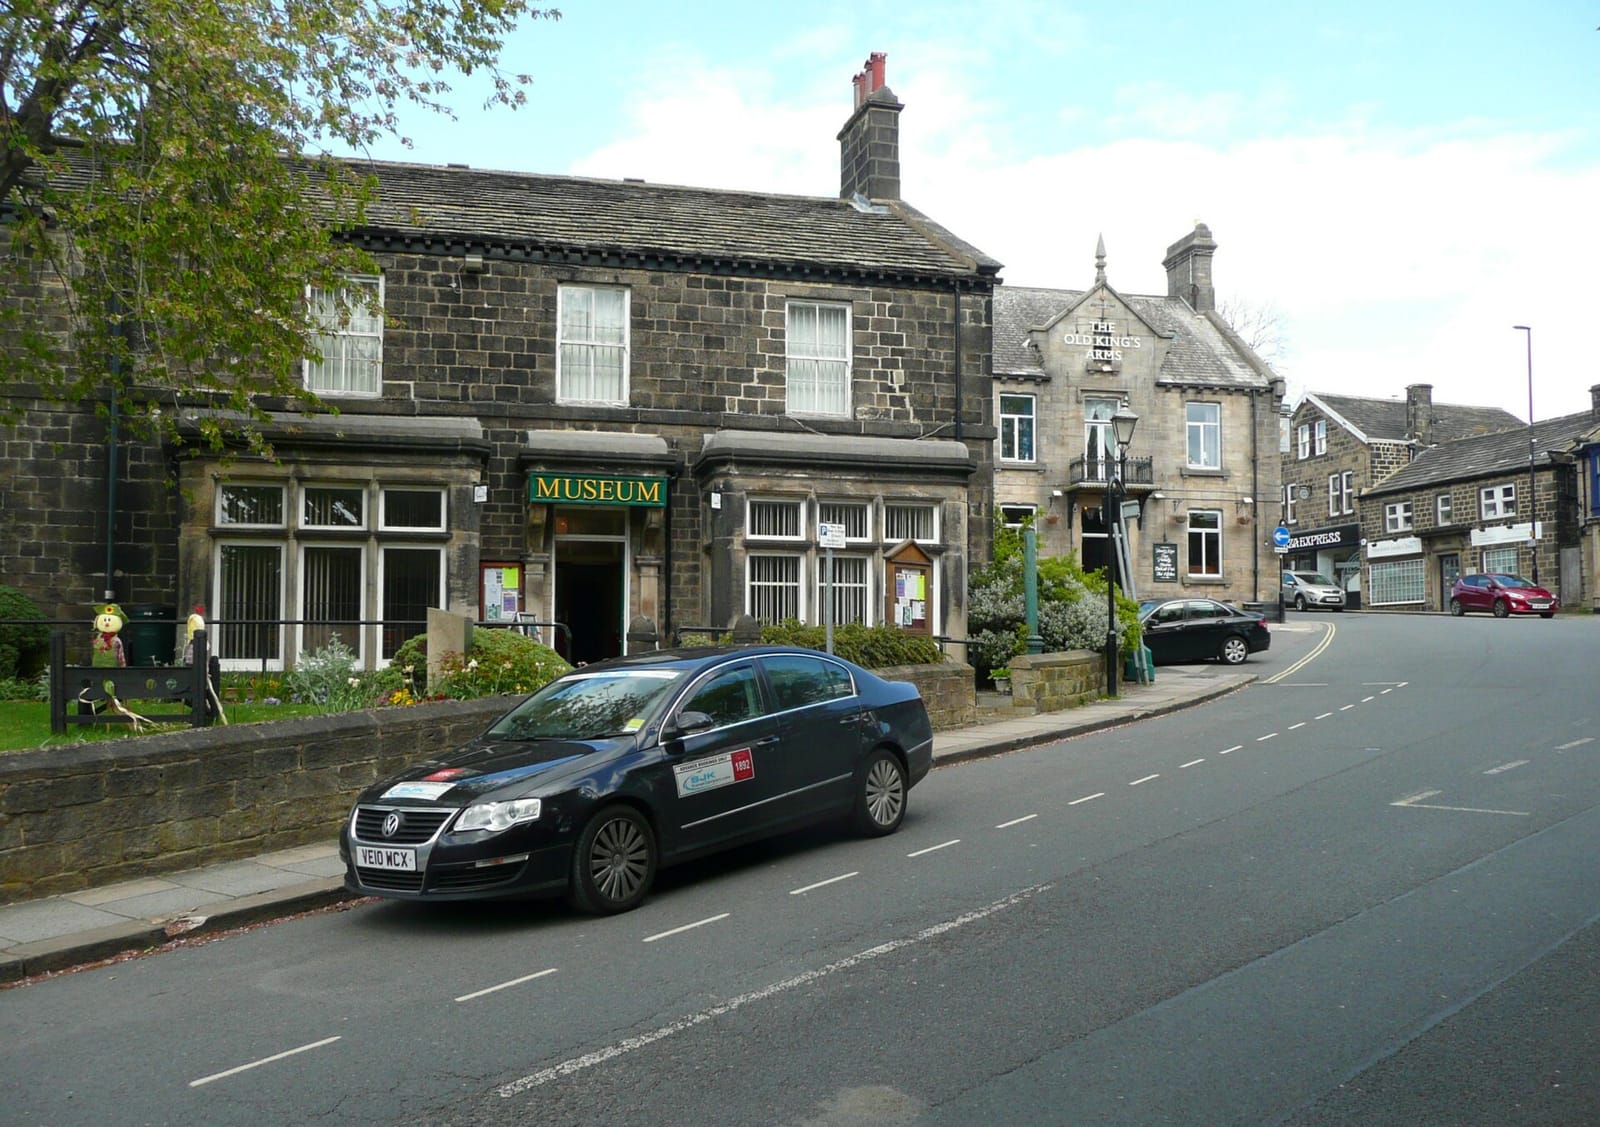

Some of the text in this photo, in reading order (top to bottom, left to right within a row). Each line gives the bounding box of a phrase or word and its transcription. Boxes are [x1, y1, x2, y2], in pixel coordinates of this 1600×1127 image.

[1089, 321, 1116, 332] THE
[1064, 334, 1141, 348] OLD KING'S
[1086, 349, 1122, 361] ARMS
[535, 478, 660, 502] MUSEUM
[735, 759, 750, 772] 1892
[385, 850, 408, 868] WCX
